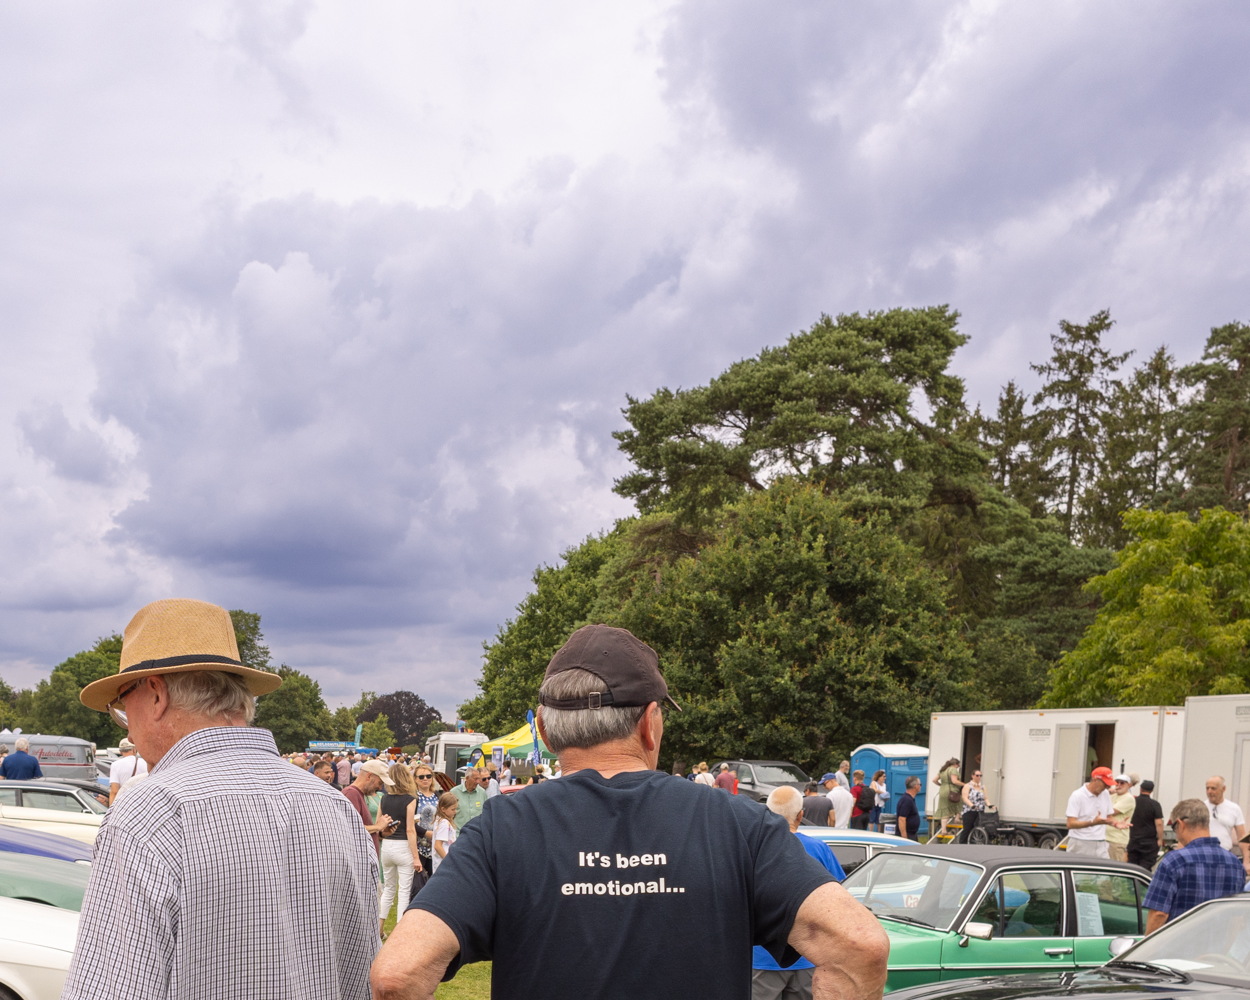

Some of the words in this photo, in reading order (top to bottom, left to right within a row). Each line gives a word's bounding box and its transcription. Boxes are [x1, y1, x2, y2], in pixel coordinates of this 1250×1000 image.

[32, 748, 73, 760] Autodelta
[579, 852, 611, 867] It's
[616, 853, 667, 869] been
[561, 878, 685, 895] emotional...
